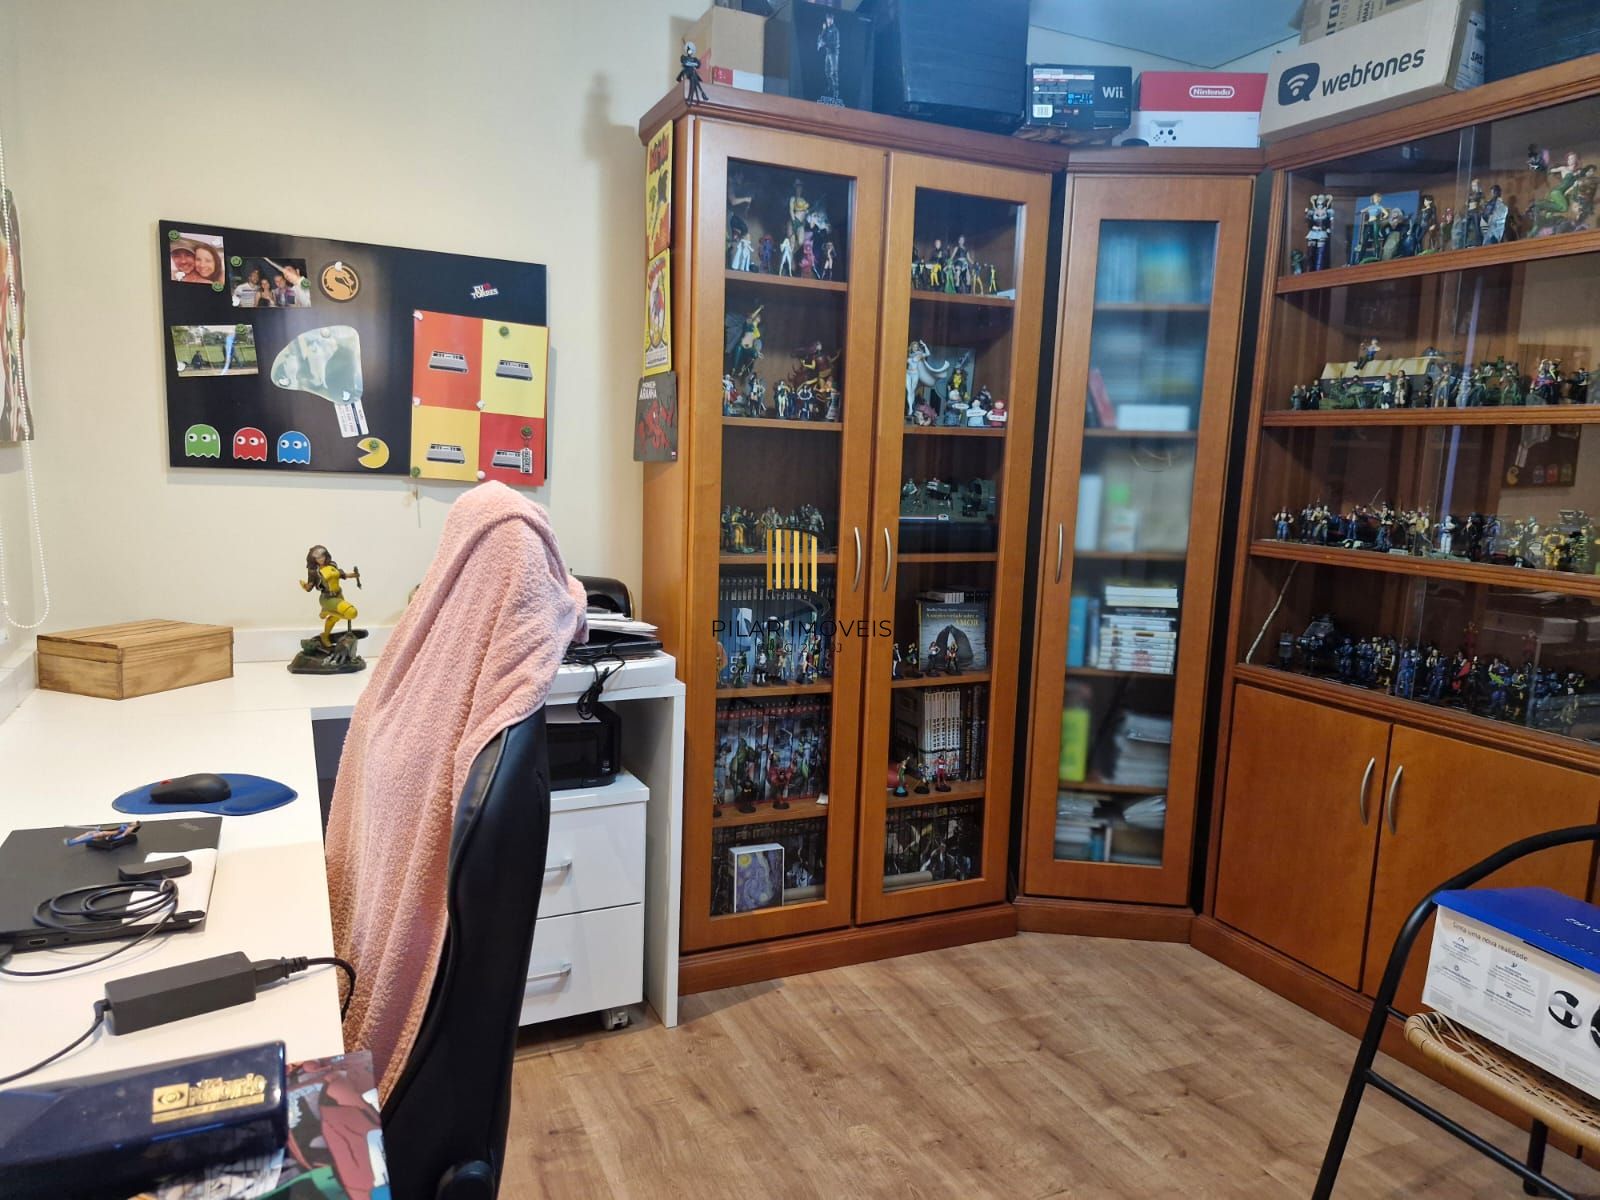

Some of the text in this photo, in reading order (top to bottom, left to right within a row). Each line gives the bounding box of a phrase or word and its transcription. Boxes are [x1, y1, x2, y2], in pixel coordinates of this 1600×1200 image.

[1321, 48, 1426, 97] webfones
[1102, 86, 1123, 99] Wii
[1193, 87, 1231, 96] Nintendo
[1497, 944, 1529, 962] realidade
